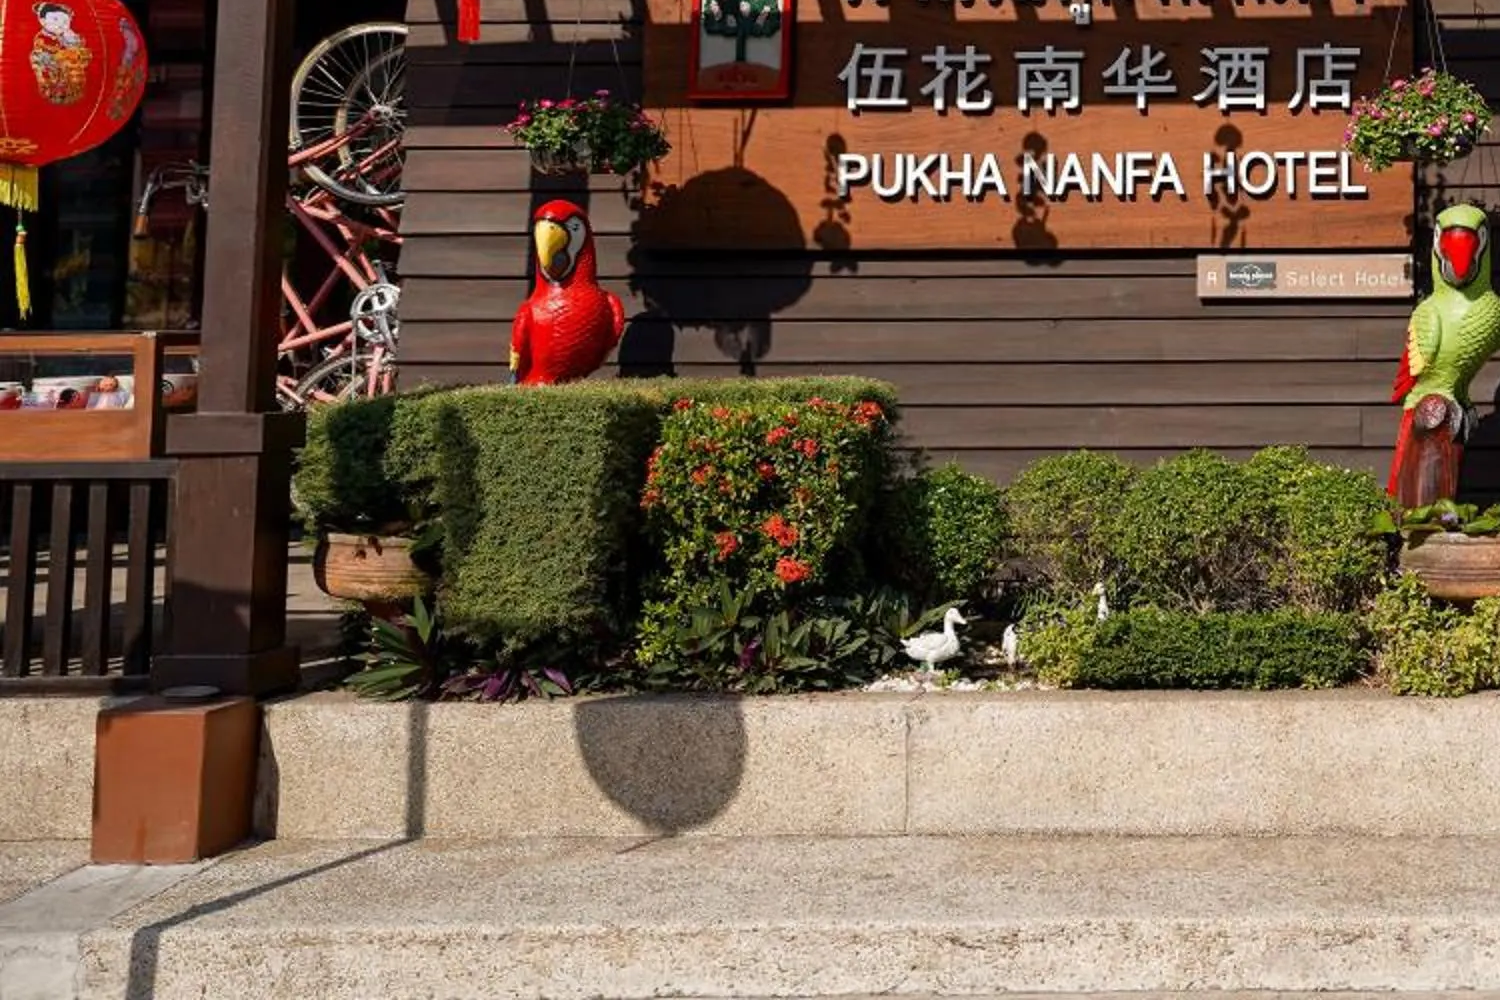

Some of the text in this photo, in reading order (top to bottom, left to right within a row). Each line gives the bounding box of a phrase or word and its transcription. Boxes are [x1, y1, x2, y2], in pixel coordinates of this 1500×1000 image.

[838, 43, 1361, 110] 伍花南华酒店
[838, 152, 1367, 197] PUKHA NANFA HOTEL
[1285, 271, 1344, 287] Select
